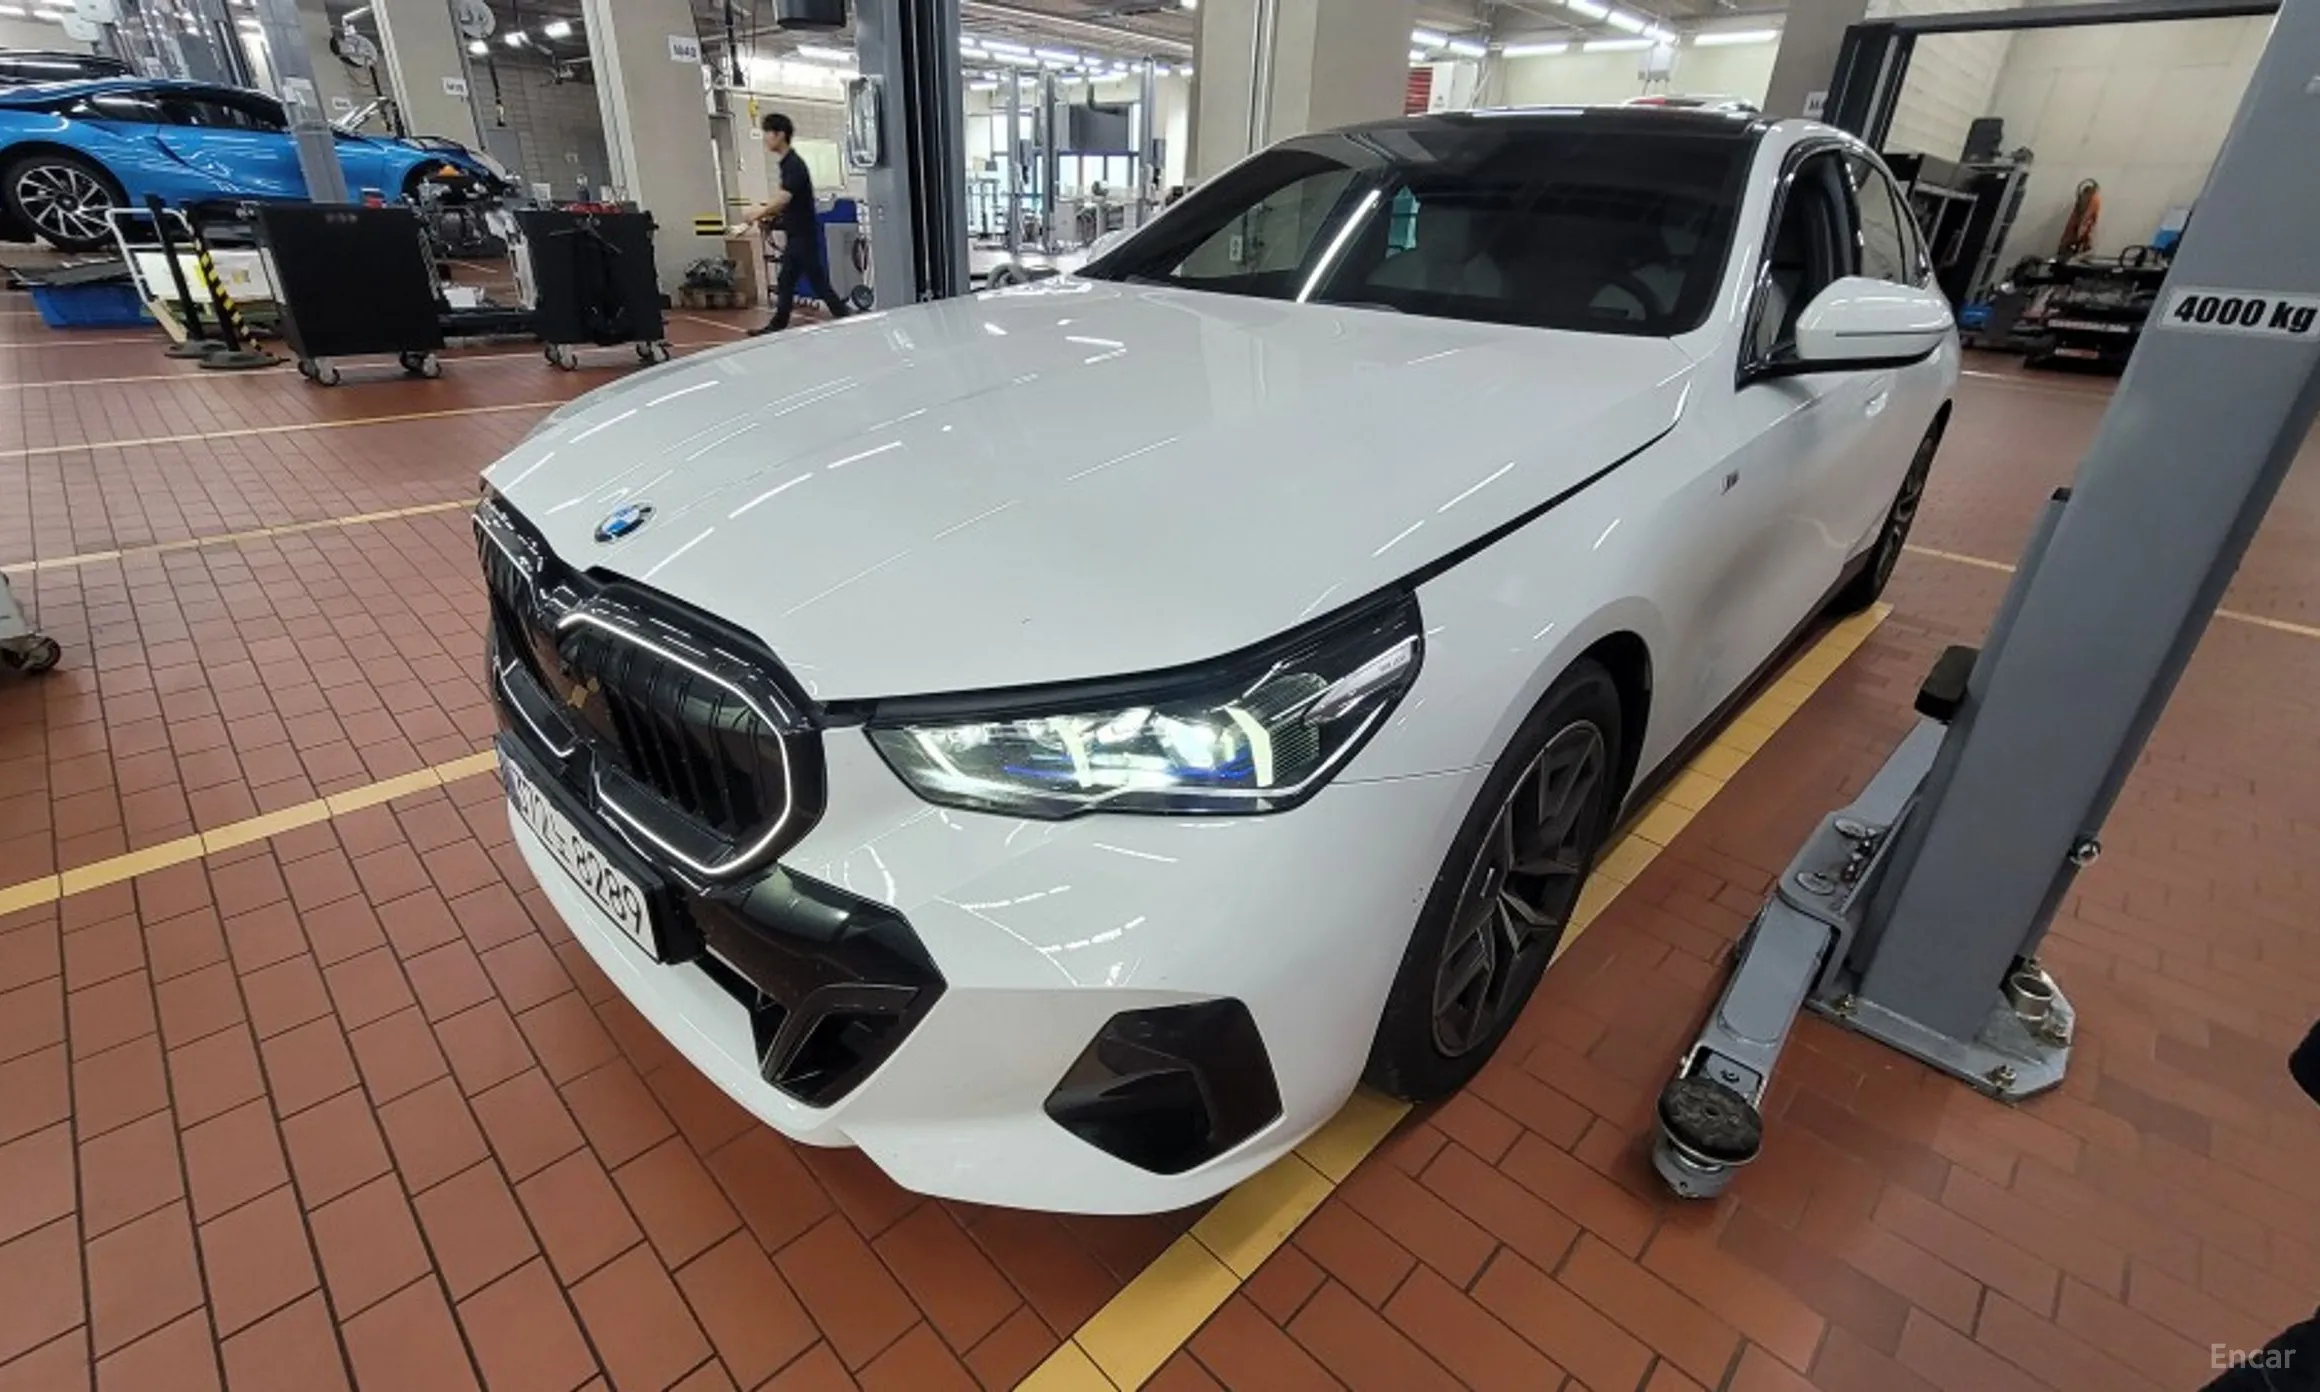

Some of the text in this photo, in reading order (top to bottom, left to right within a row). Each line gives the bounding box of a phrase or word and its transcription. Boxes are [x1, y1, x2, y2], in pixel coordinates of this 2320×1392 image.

[2174, 294, 2318, 333] 4000 kg
[571, 834, 642, 934] 8289
